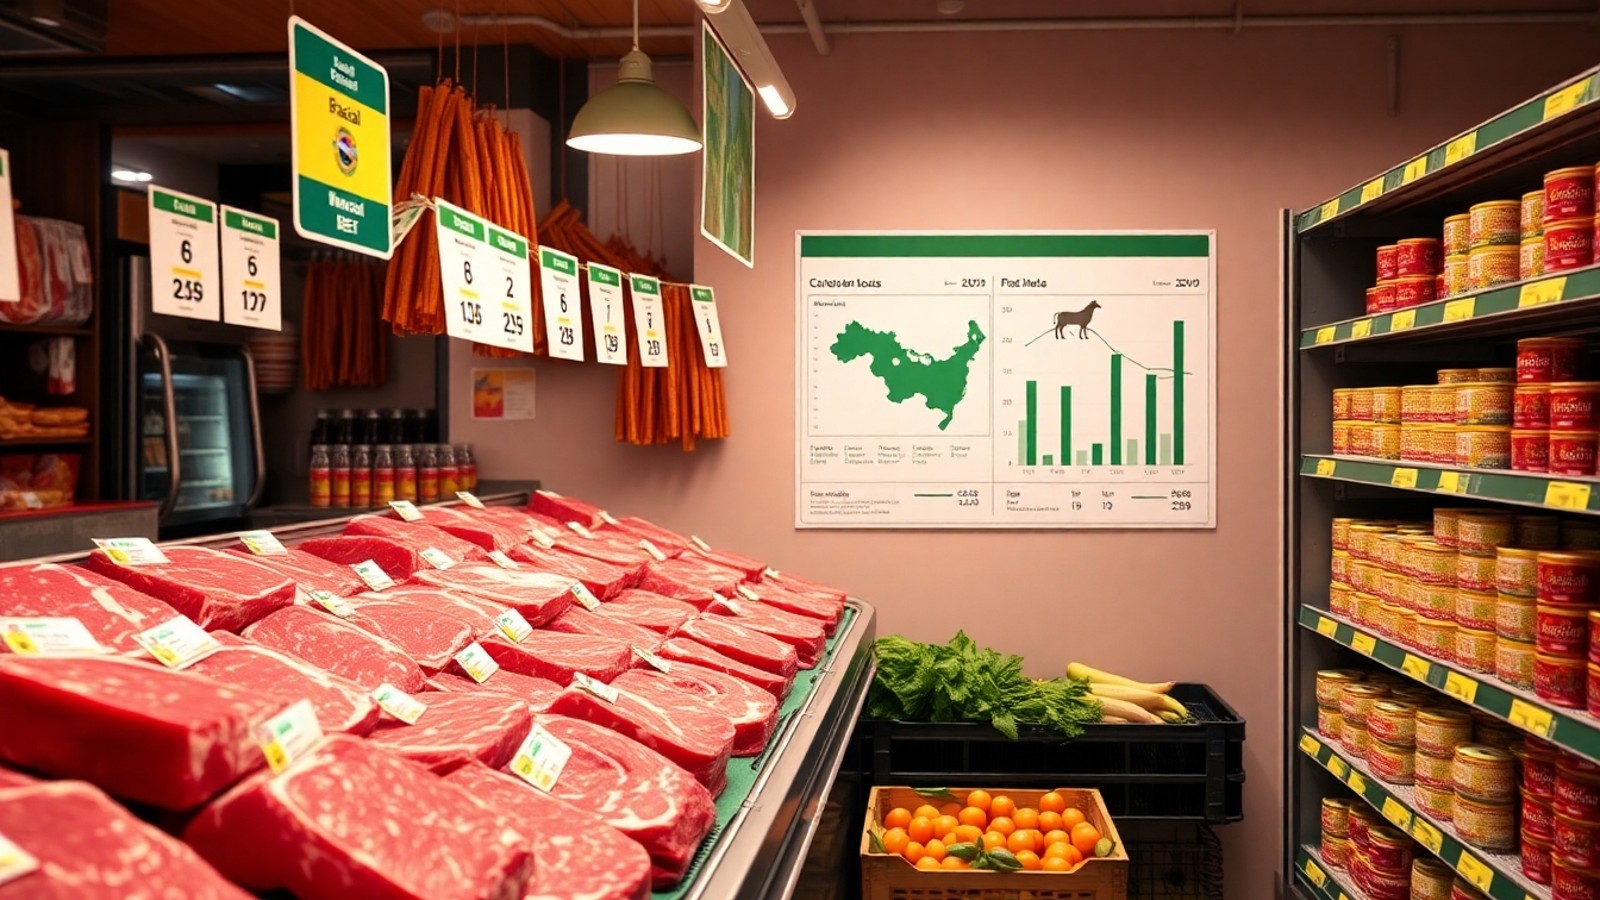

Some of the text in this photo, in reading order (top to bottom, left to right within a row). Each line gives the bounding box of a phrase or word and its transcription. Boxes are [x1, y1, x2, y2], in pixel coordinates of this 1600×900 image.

[181, 240, 192, 264] 6
[248, 255, 258, 277] 6
[464, 261, 473, 285] 8
[506, 276, 514, 299] 2
[560, 293, 568, 314] 6
